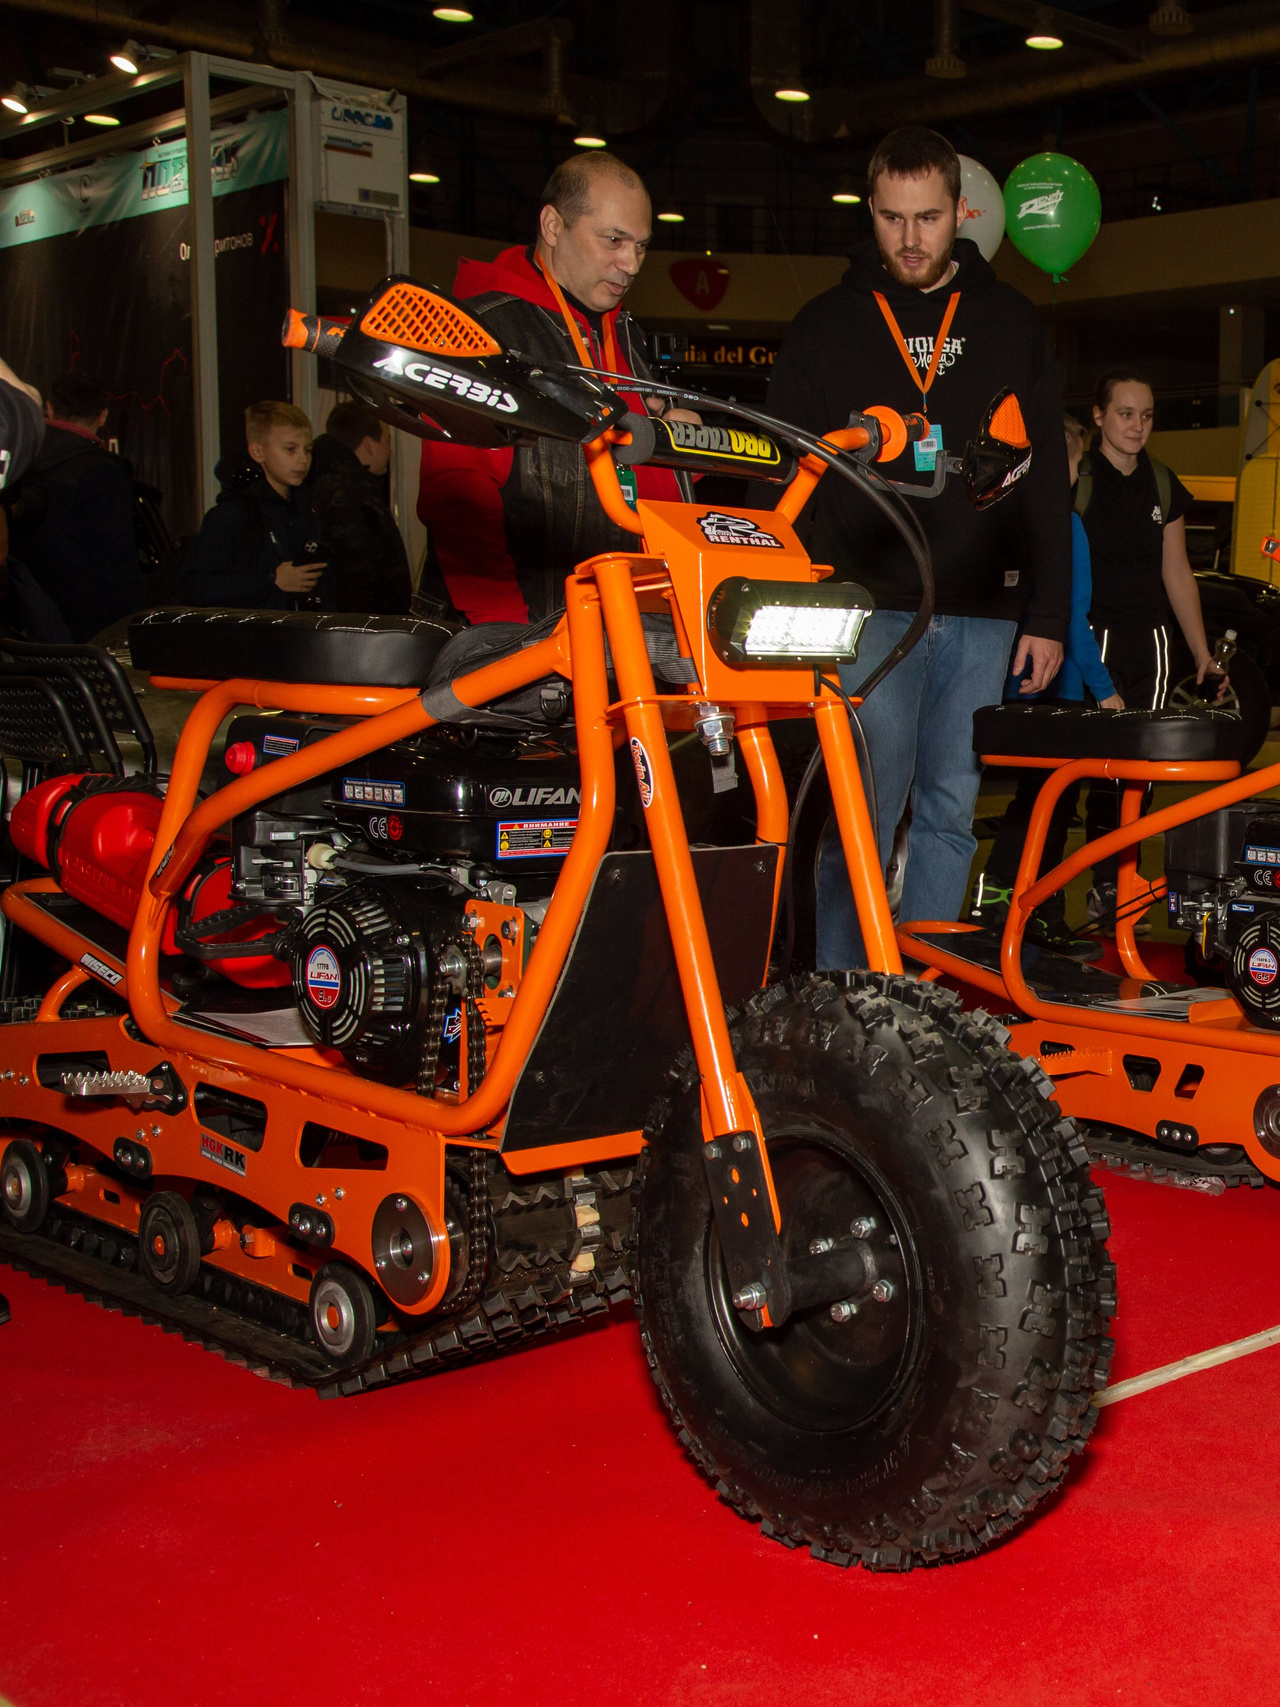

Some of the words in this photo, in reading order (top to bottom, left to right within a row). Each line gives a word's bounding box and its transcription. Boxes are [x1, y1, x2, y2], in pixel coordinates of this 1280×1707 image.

[214, 232, 254, 257] ритонов
[713, 346, 744, 364] del
[373, 350, 520, 414] ACERBIS
[708, 534, 781, 548] RENTHAL
[632, 742, 647, 780] Twin
[512, 787, 582, 806] LIFAN
[638, 780, 652, 806] Air
[523, 821, 570, 829] ВНИМАНИЕ
[310, 971, 338, 981] LIFAN
